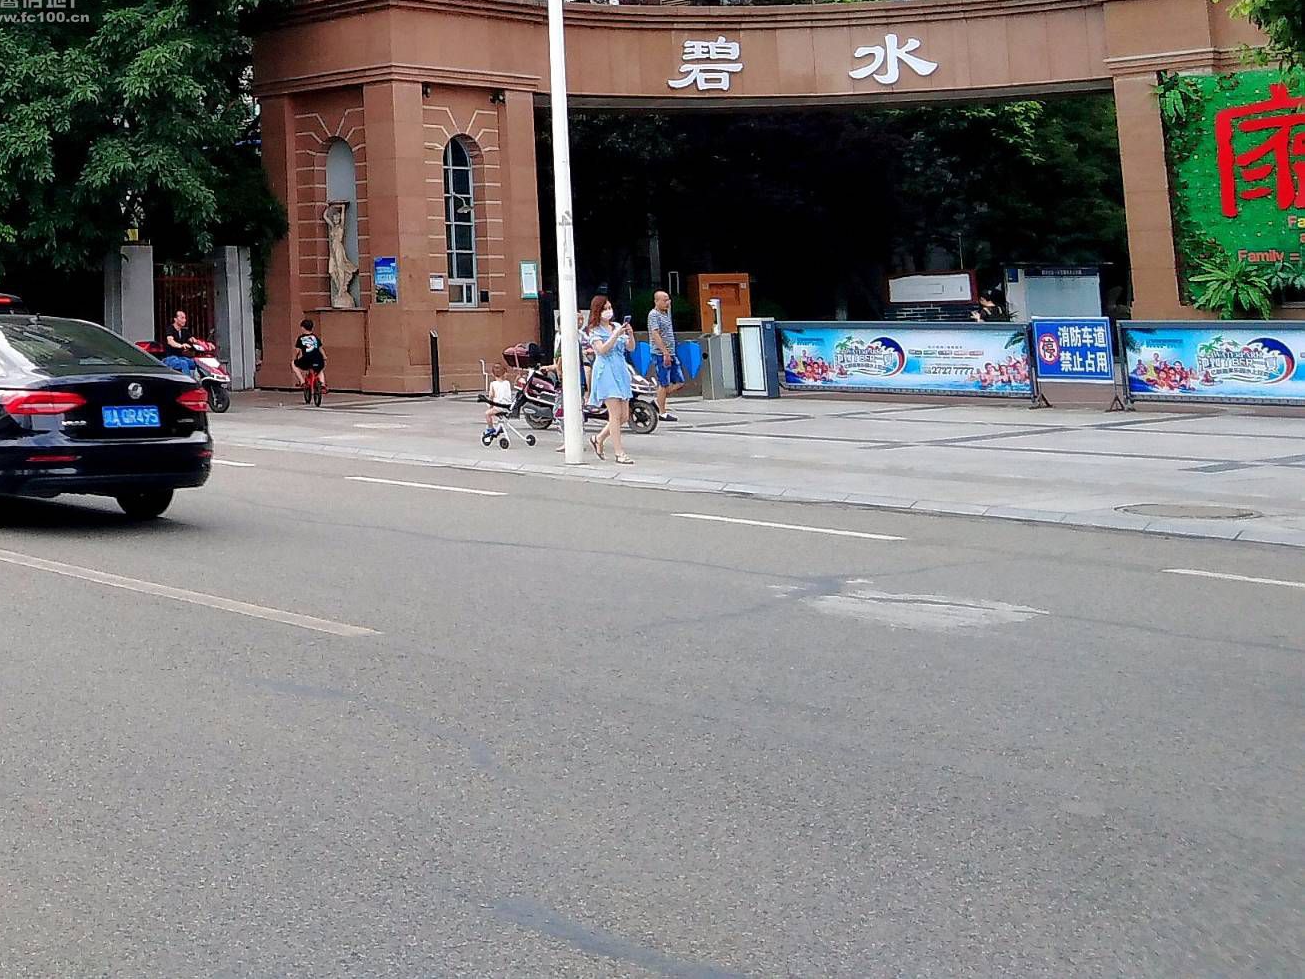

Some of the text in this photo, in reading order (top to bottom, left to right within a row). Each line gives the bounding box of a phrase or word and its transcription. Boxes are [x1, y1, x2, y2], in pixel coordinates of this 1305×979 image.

[667, 34, 939, 92] 碧水
[1058, 326, 1107, 347] 消防车道
[1060, 351, 1108, 373] 禁止占用
